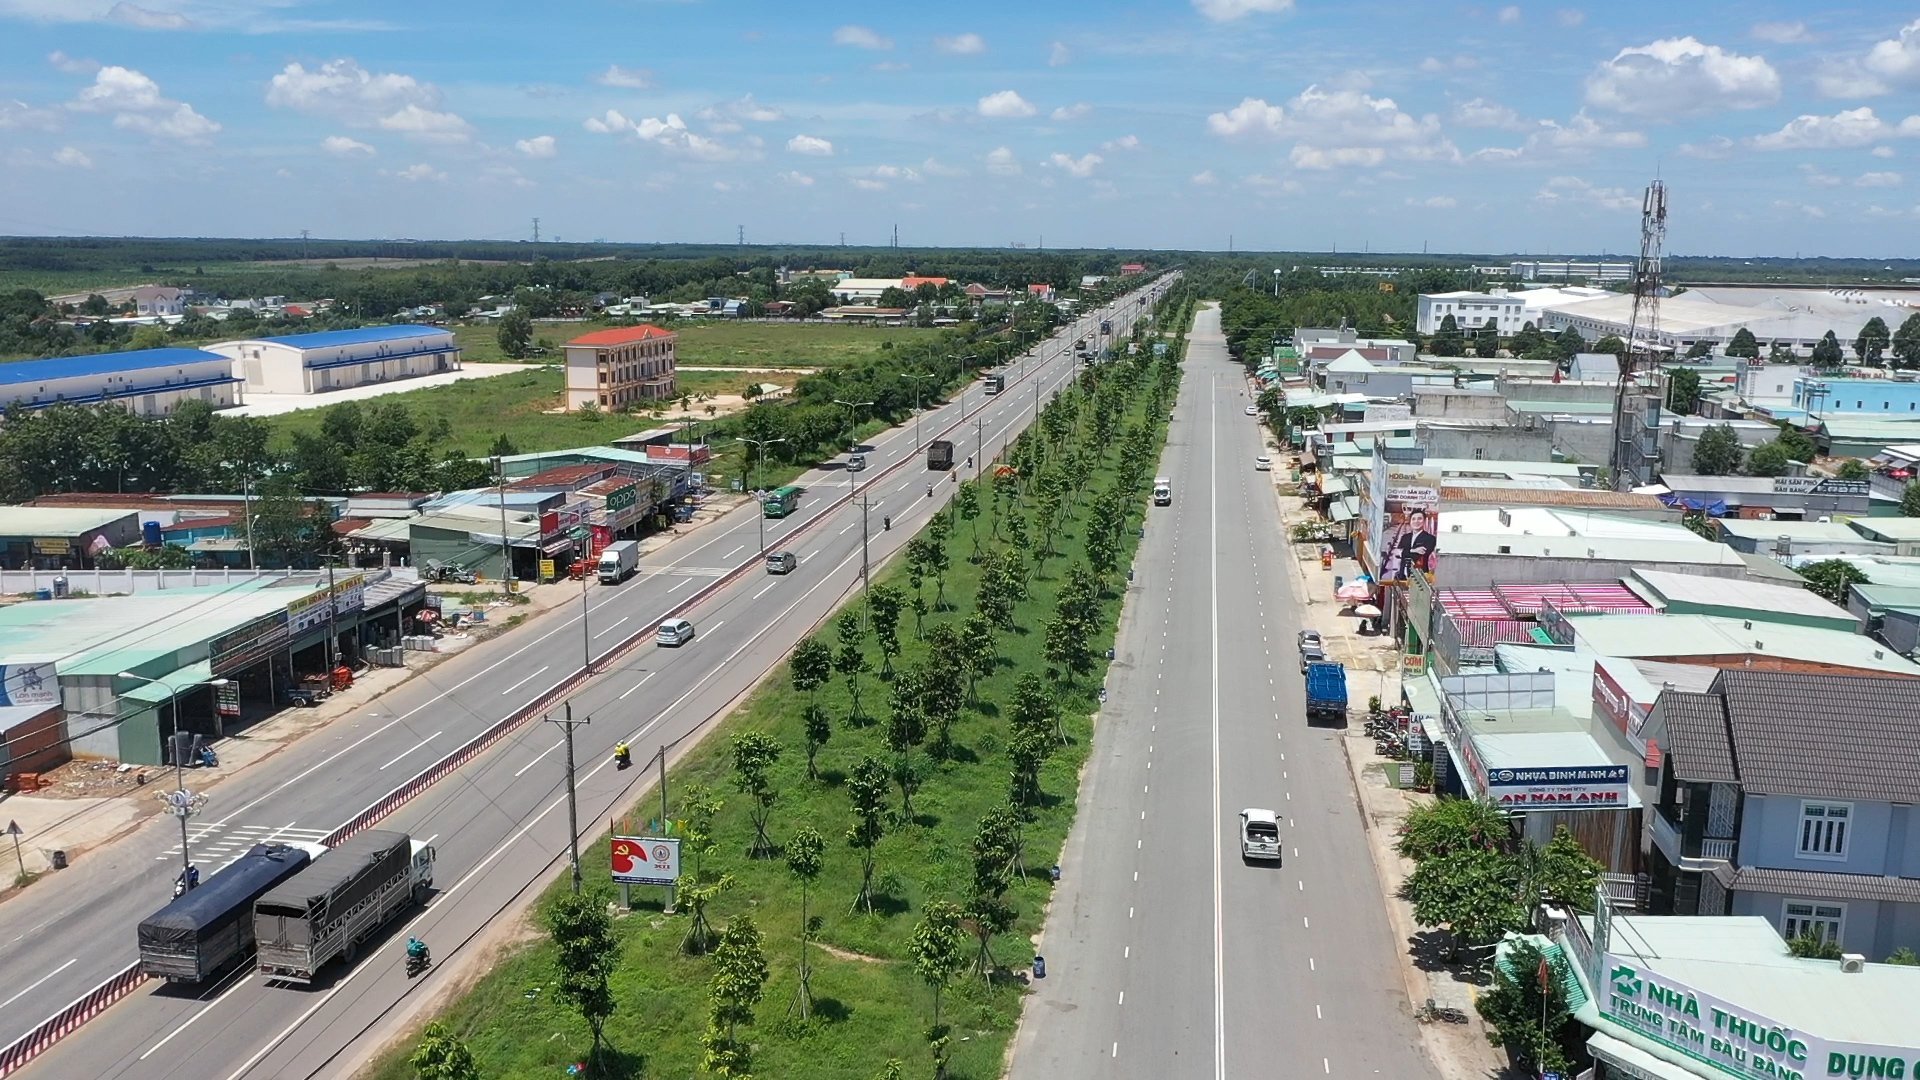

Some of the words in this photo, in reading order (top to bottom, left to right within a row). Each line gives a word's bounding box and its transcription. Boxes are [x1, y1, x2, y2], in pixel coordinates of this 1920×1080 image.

[1388, 472, 1417, 480] HDBank
[1501, 793, 1527, 804] AN
[1531, 793, 1572, 804] NAM
[1577, 792, 1618, 803] ANH
[1610, 993, 1663, 1026] TRUNG
[1668, 1018, 1705, 1045] TÂM
[1711, 1035, 1747, 1062] BÀU
[1648, 980, 1700, 1020] NHÀ
[1711, 1006, 1808, 1061] THUỐC
